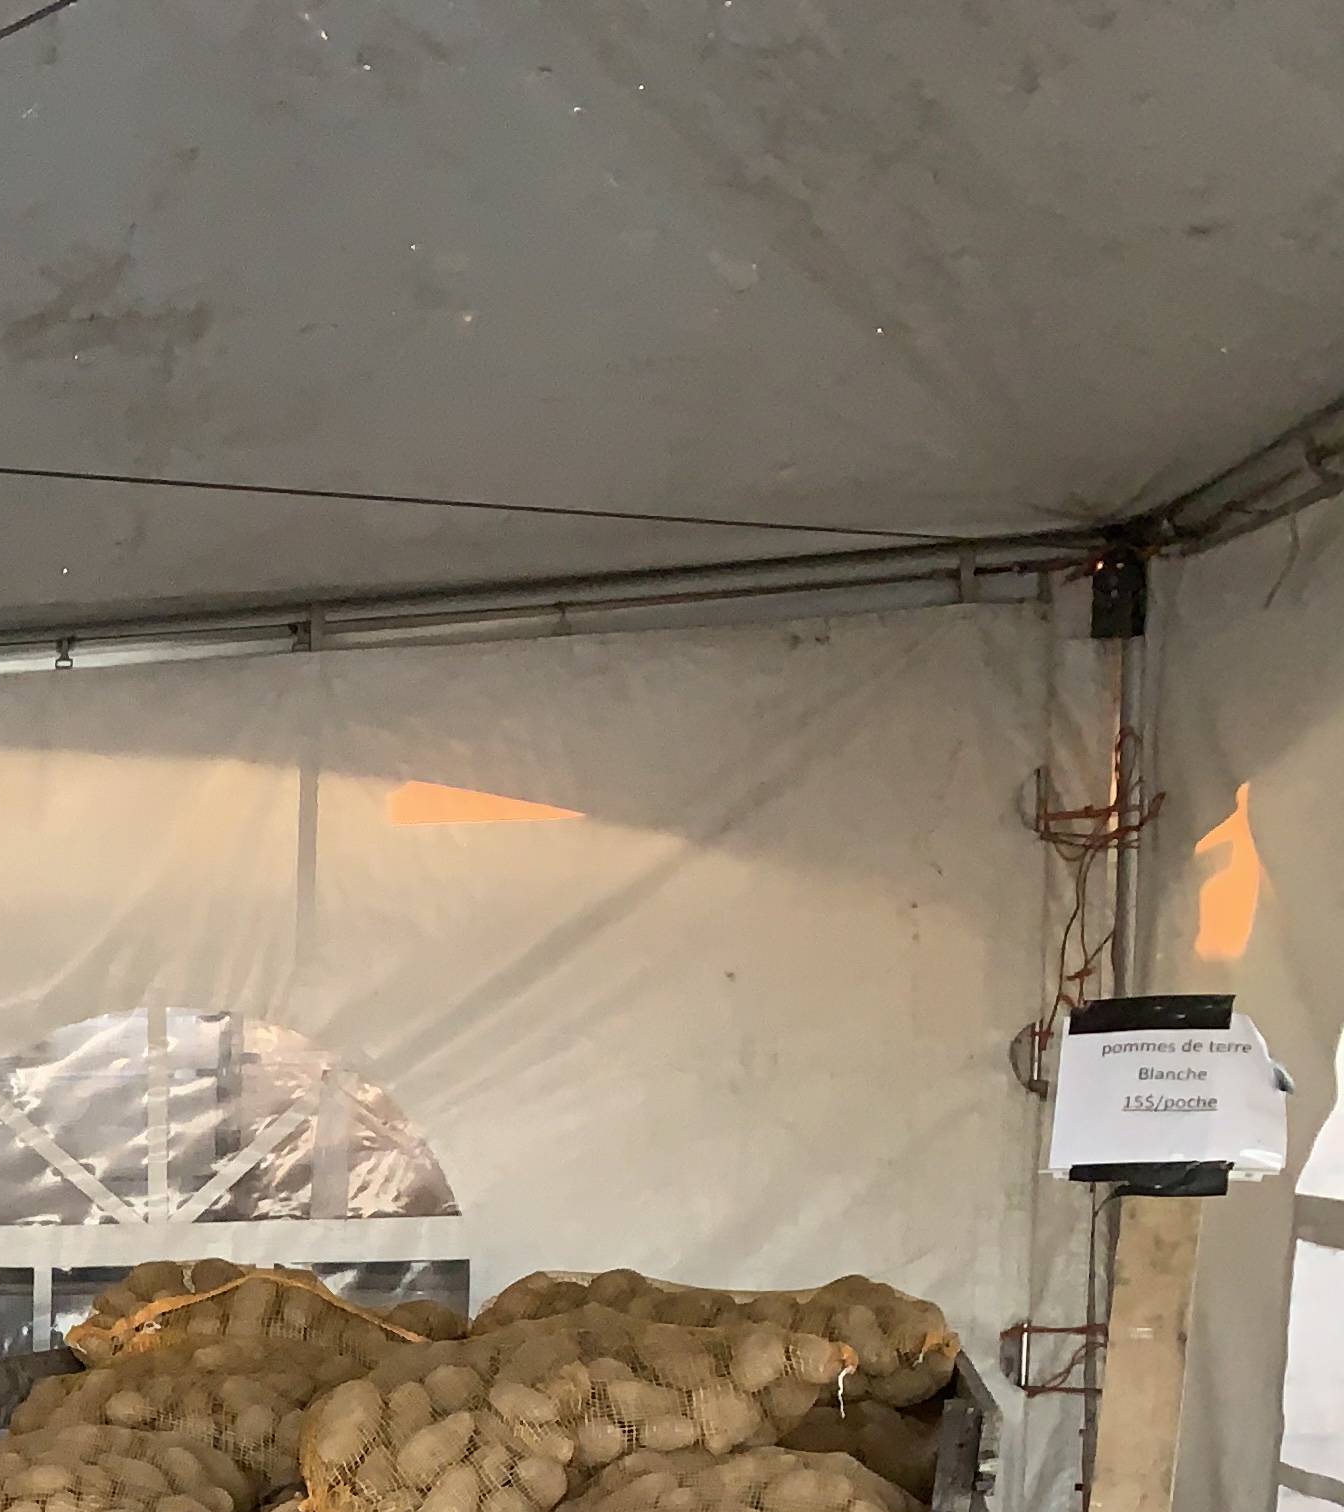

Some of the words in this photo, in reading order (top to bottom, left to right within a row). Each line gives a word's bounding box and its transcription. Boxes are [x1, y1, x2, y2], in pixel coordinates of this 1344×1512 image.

[1101, 1040, 1175, 1057] pommes
[1181, 1038, 1204, 1053] de
[1209, 1040, 1252, 1054] terre
[1138, 1066, 1207, 1081] Blanche
[1123, 1094, 1218, 1112] 15$/poche
